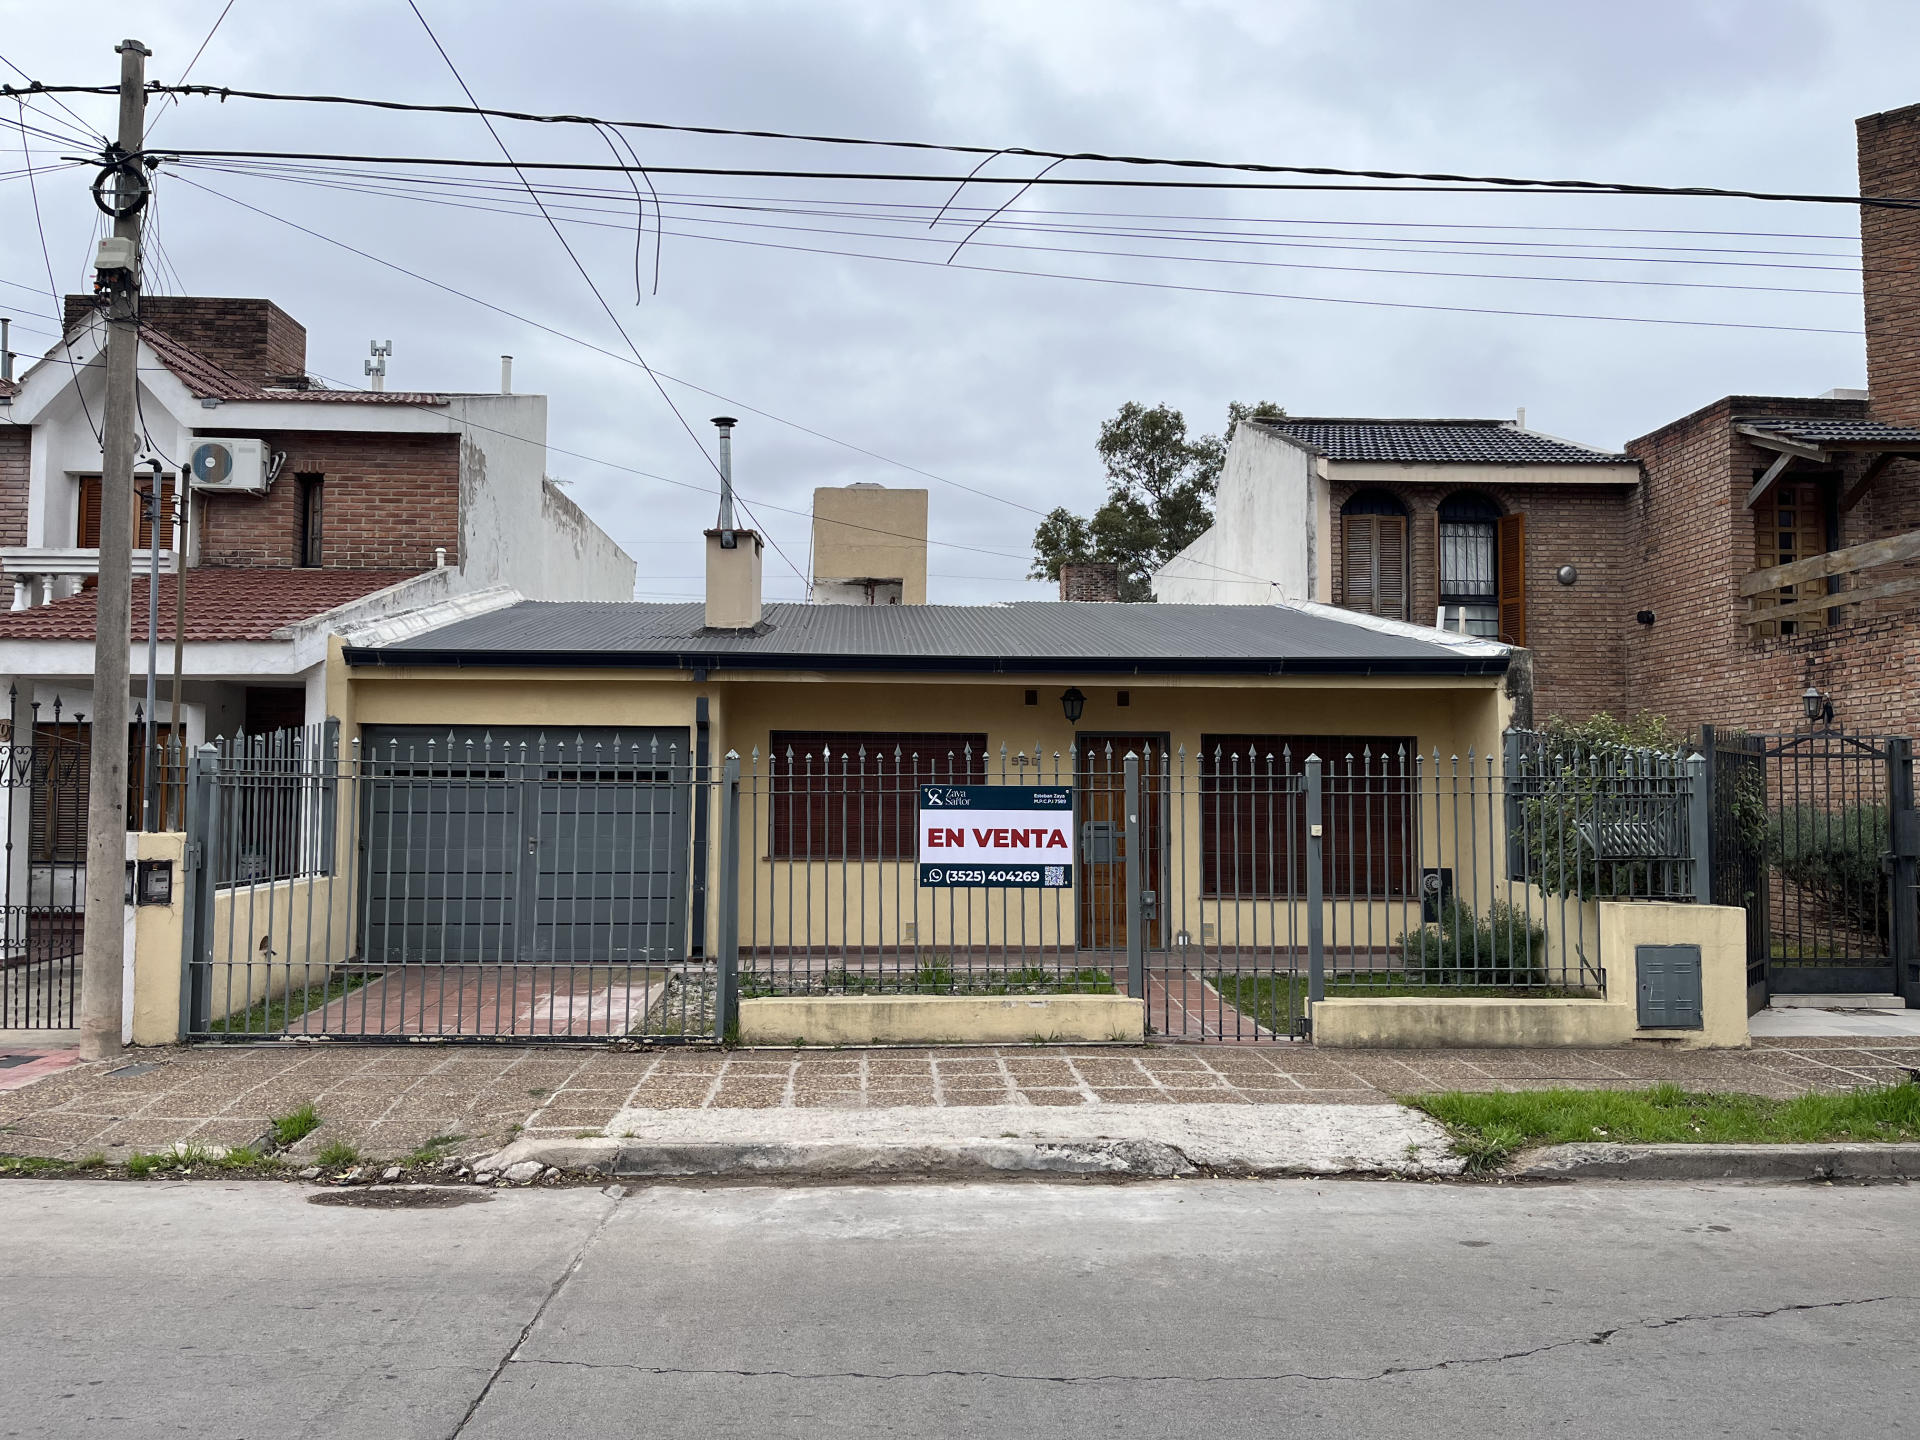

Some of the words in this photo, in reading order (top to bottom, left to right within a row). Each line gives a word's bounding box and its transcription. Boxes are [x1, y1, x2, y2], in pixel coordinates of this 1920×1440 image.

[928, 828, 965, 848] EN
[972, 828, 1068, 848] VENTA
[945, 870, 986, 884] (3525)
[988, 870, 1040, 882] 404269
